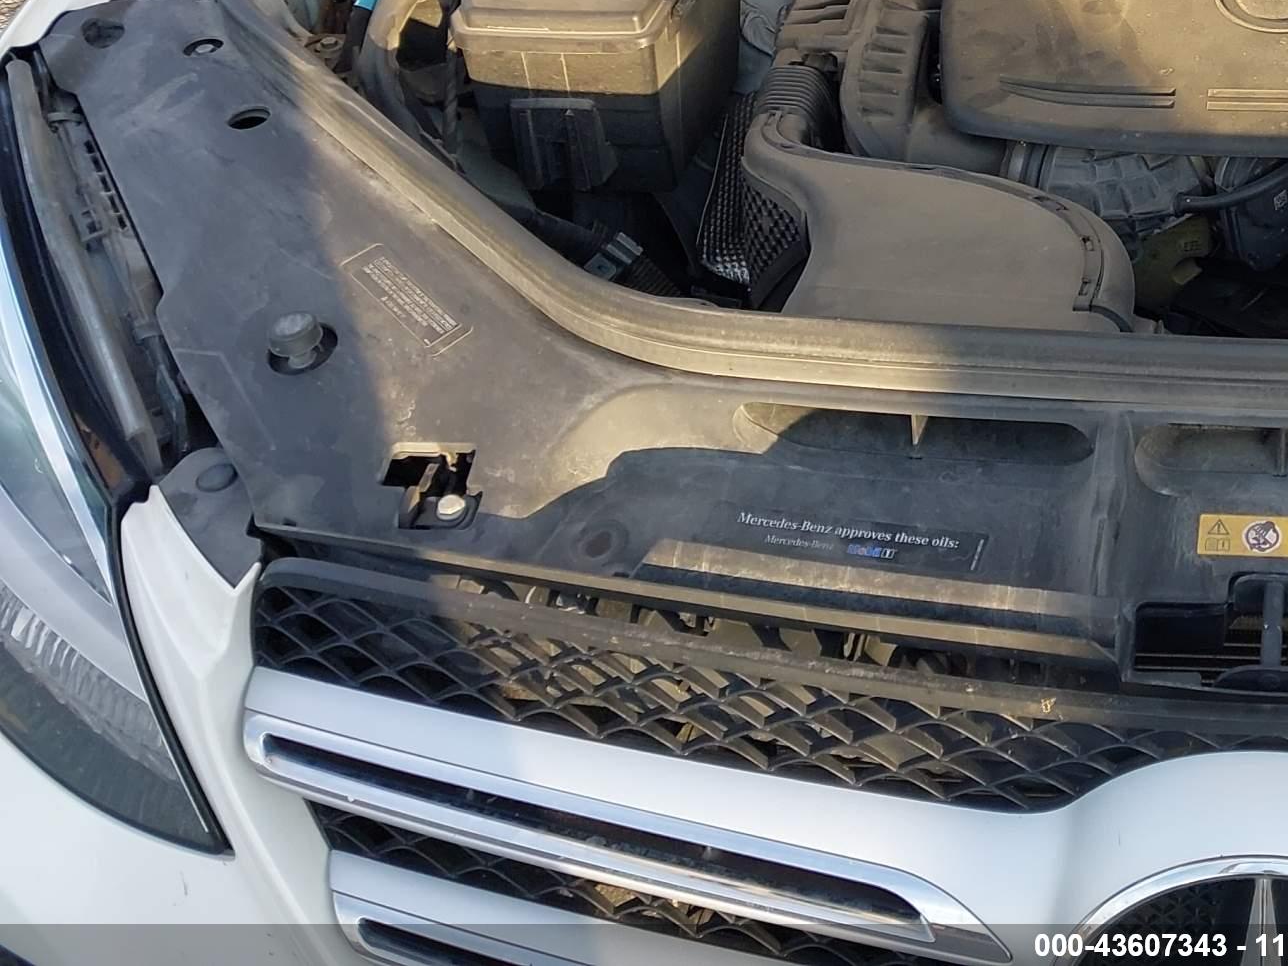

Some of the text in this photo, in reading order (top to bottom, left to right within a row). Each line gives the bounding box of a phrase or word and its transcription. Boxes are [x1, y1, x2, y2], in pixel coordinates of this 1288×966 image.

[736, 511, 960, 549] Mercedes-Benz approves these oils:
[764, 534, 834, 551] Mercedes-Benz
